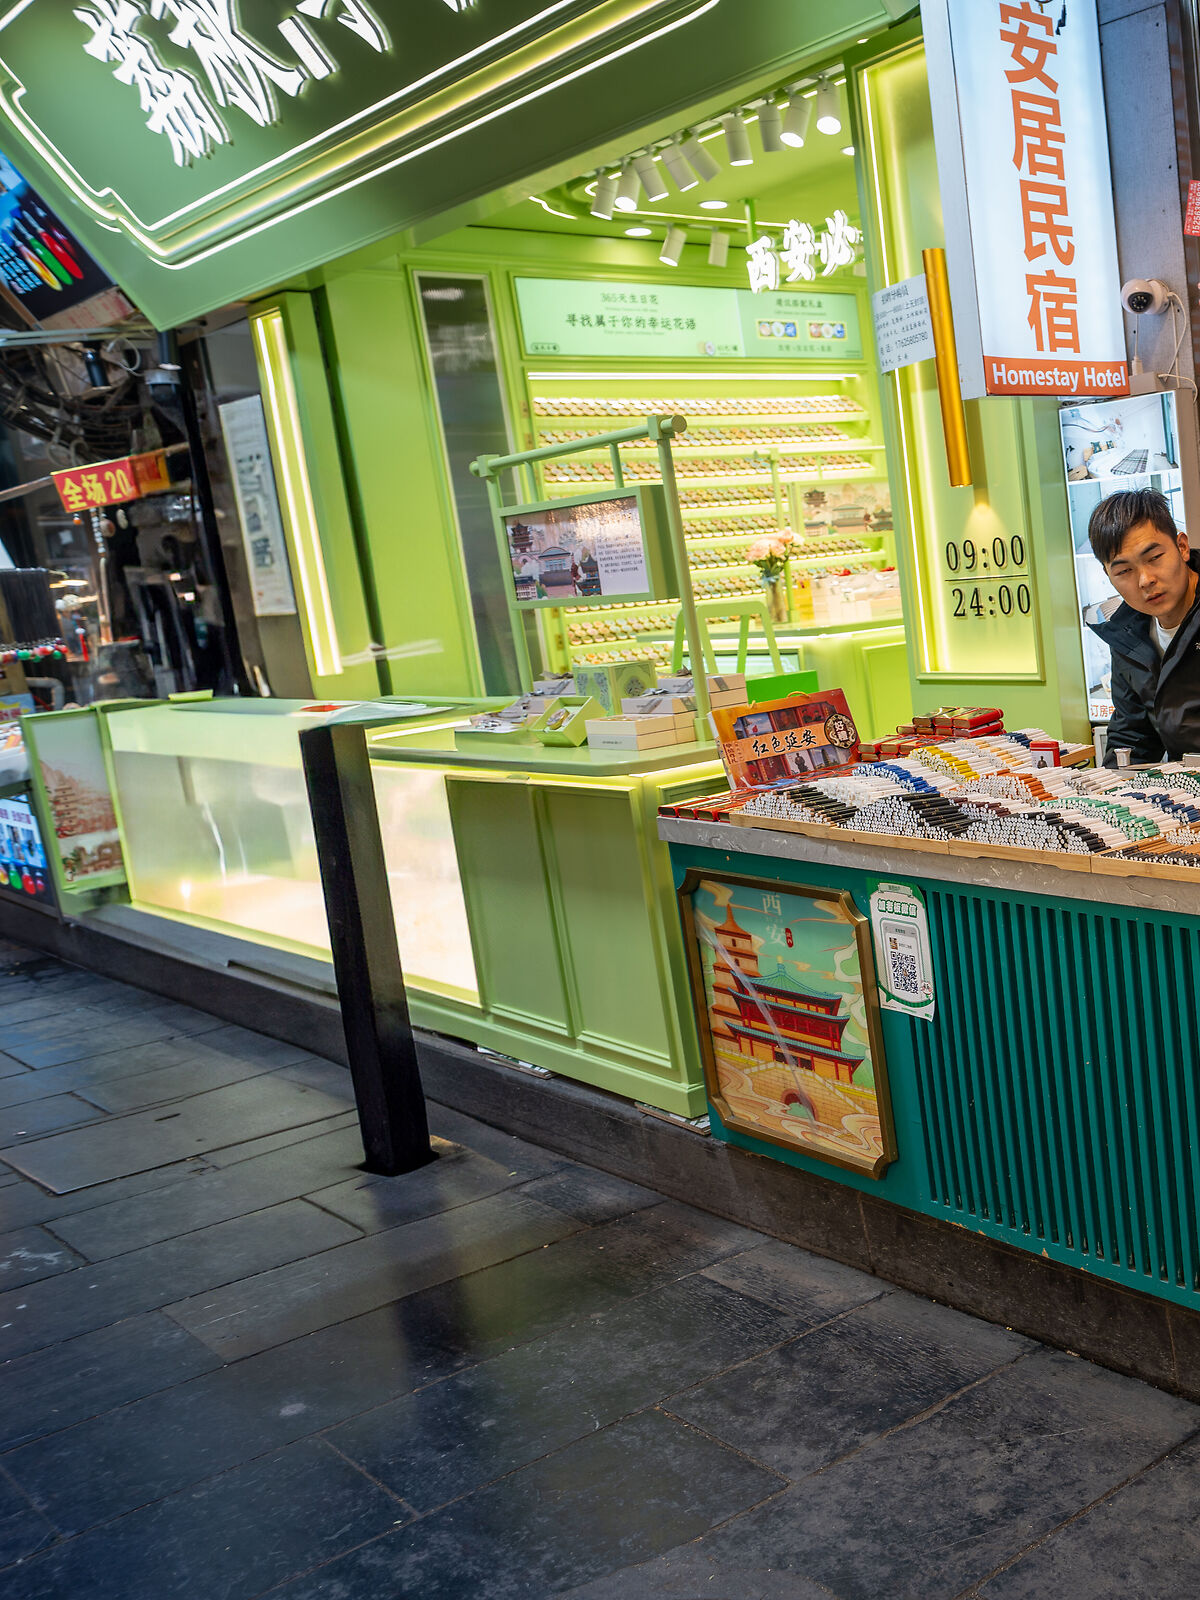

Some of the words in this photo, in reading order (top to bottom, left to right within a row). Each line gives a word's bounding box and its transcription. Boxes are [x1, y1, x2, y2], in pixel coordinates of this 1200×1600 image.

[999, 1, 1081, 354] 安居民宿
[565, 313, 697, 331] 寻找属于你的幸运花语
[992, 362, 1079, 393] Homestay
[1083, 366, 1126, 388] Hotel
[946, 535, 1024, 571] 09:00
[952, 584, 1030, 617] 24:00
[752, 729, 817, 758] 红色延安
